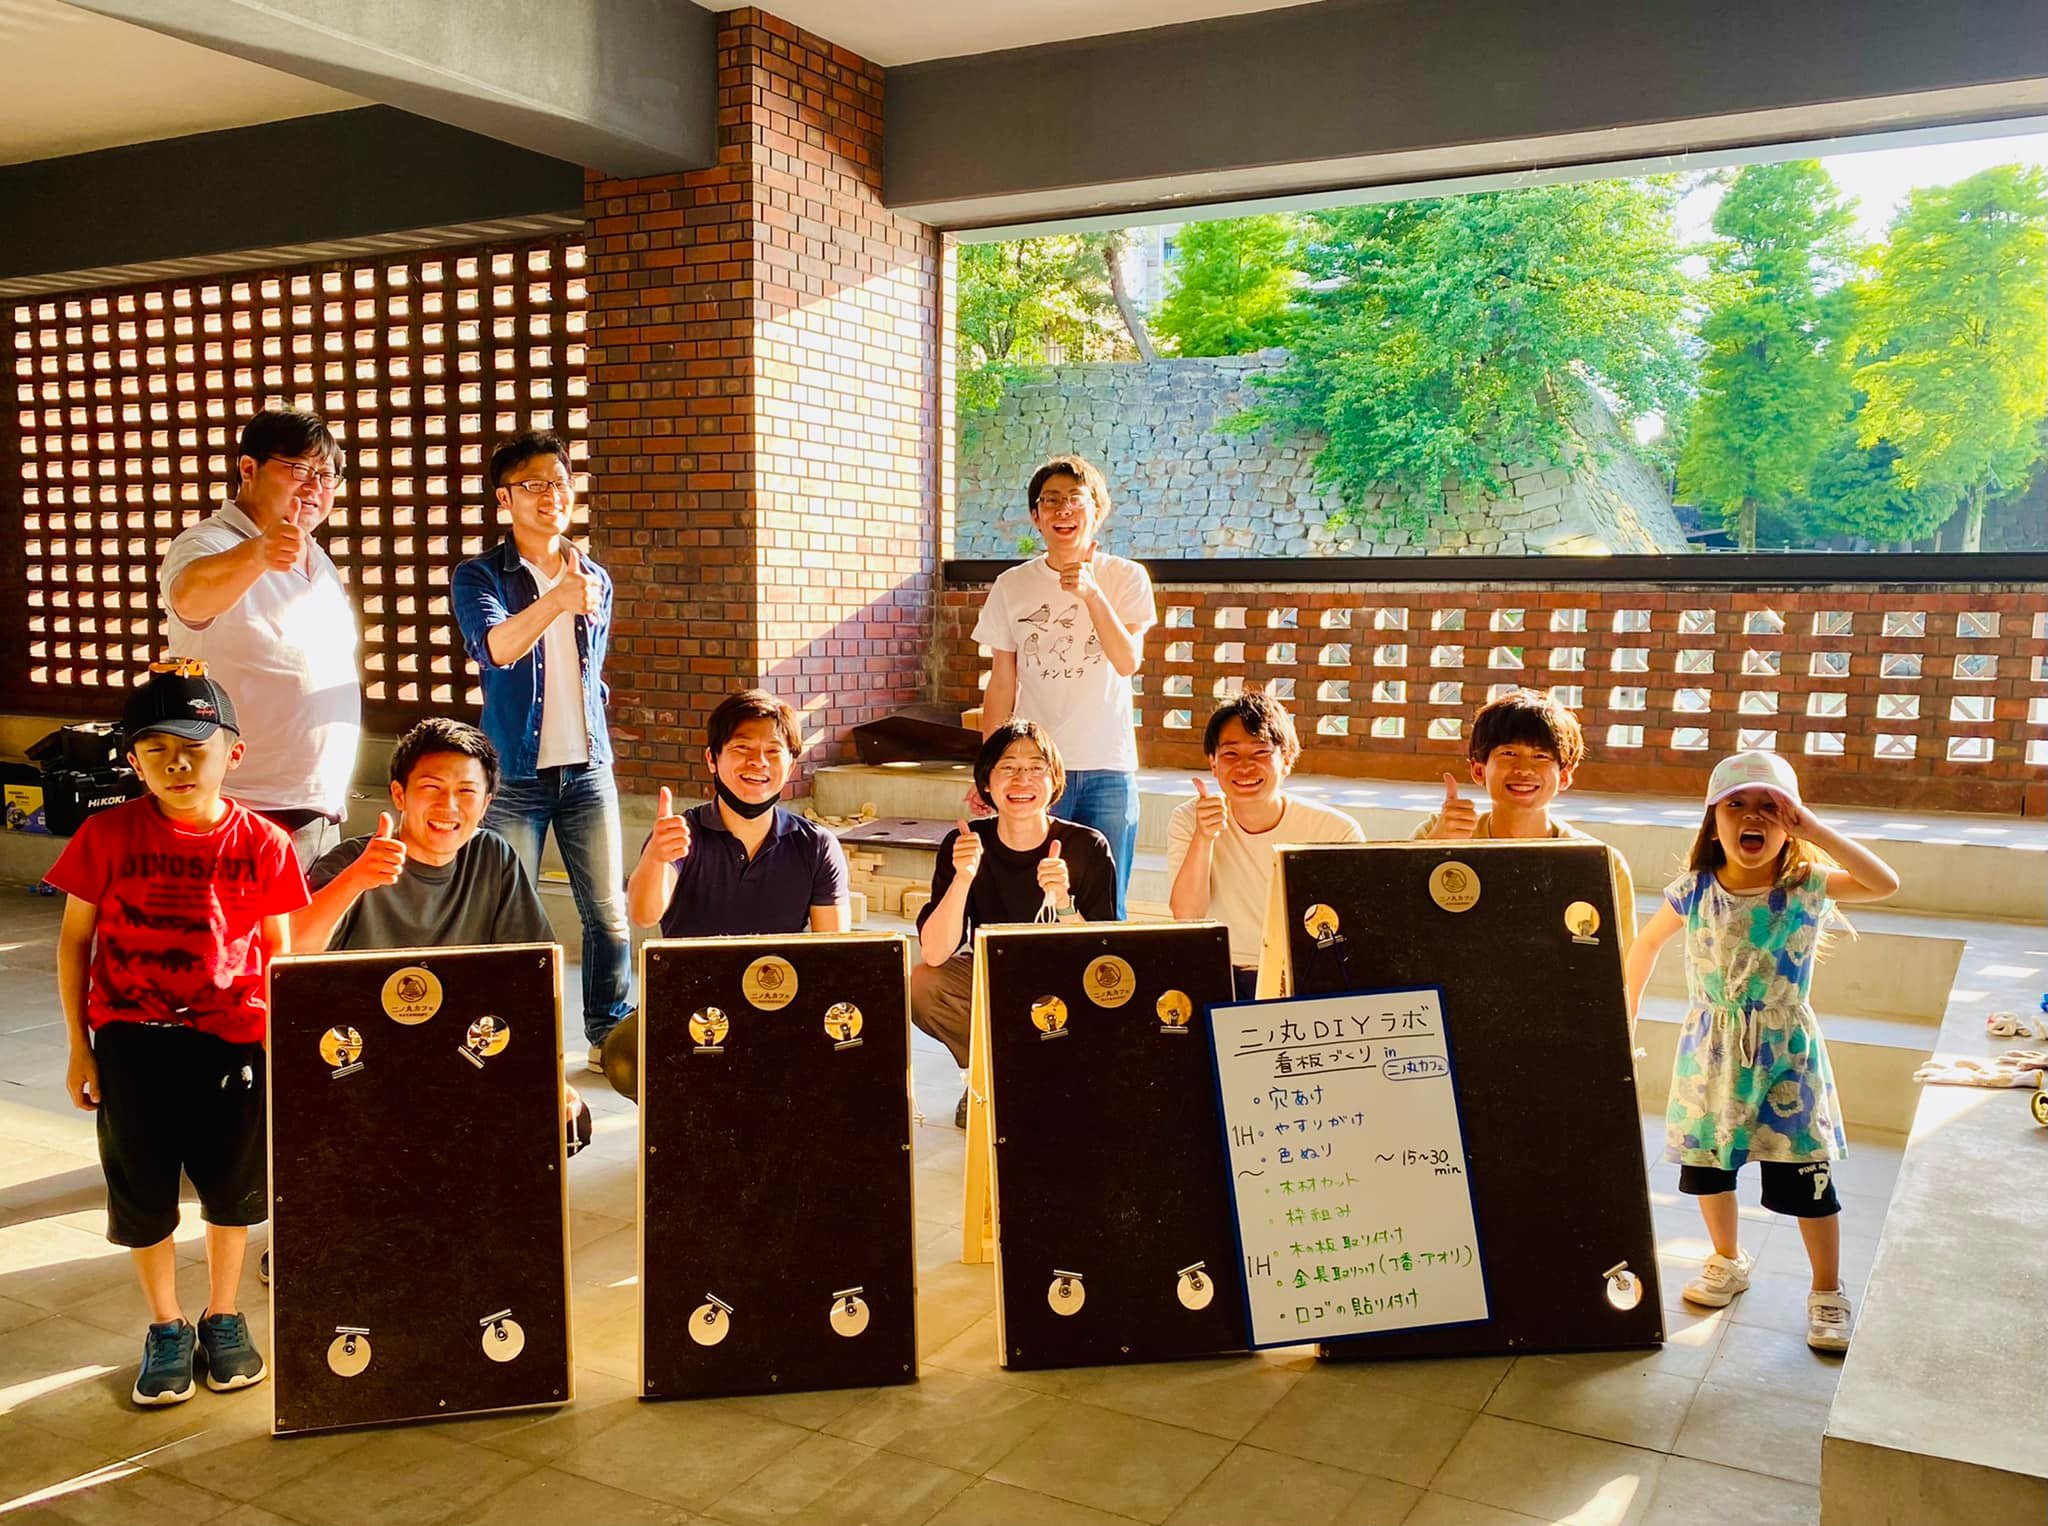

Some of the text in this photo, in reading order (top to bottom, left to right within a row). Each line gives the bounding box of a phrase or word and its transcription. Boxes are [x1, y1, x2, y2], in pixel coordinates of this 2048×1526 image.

[1274, 1045, 1371, 1075] 看板づくり
[1268, 1084, 1324, 1110] 穴あけ
[1232, 1125, 1255, 1147] 1H
[1274, 1112, 1365, 1136] やすりがけ
[1277, 1142, 1333, 1164] 色ぬり
[1434, 1163, 1461, 1176] min
[1279, 1172, 1360, 1196] 木材カット
